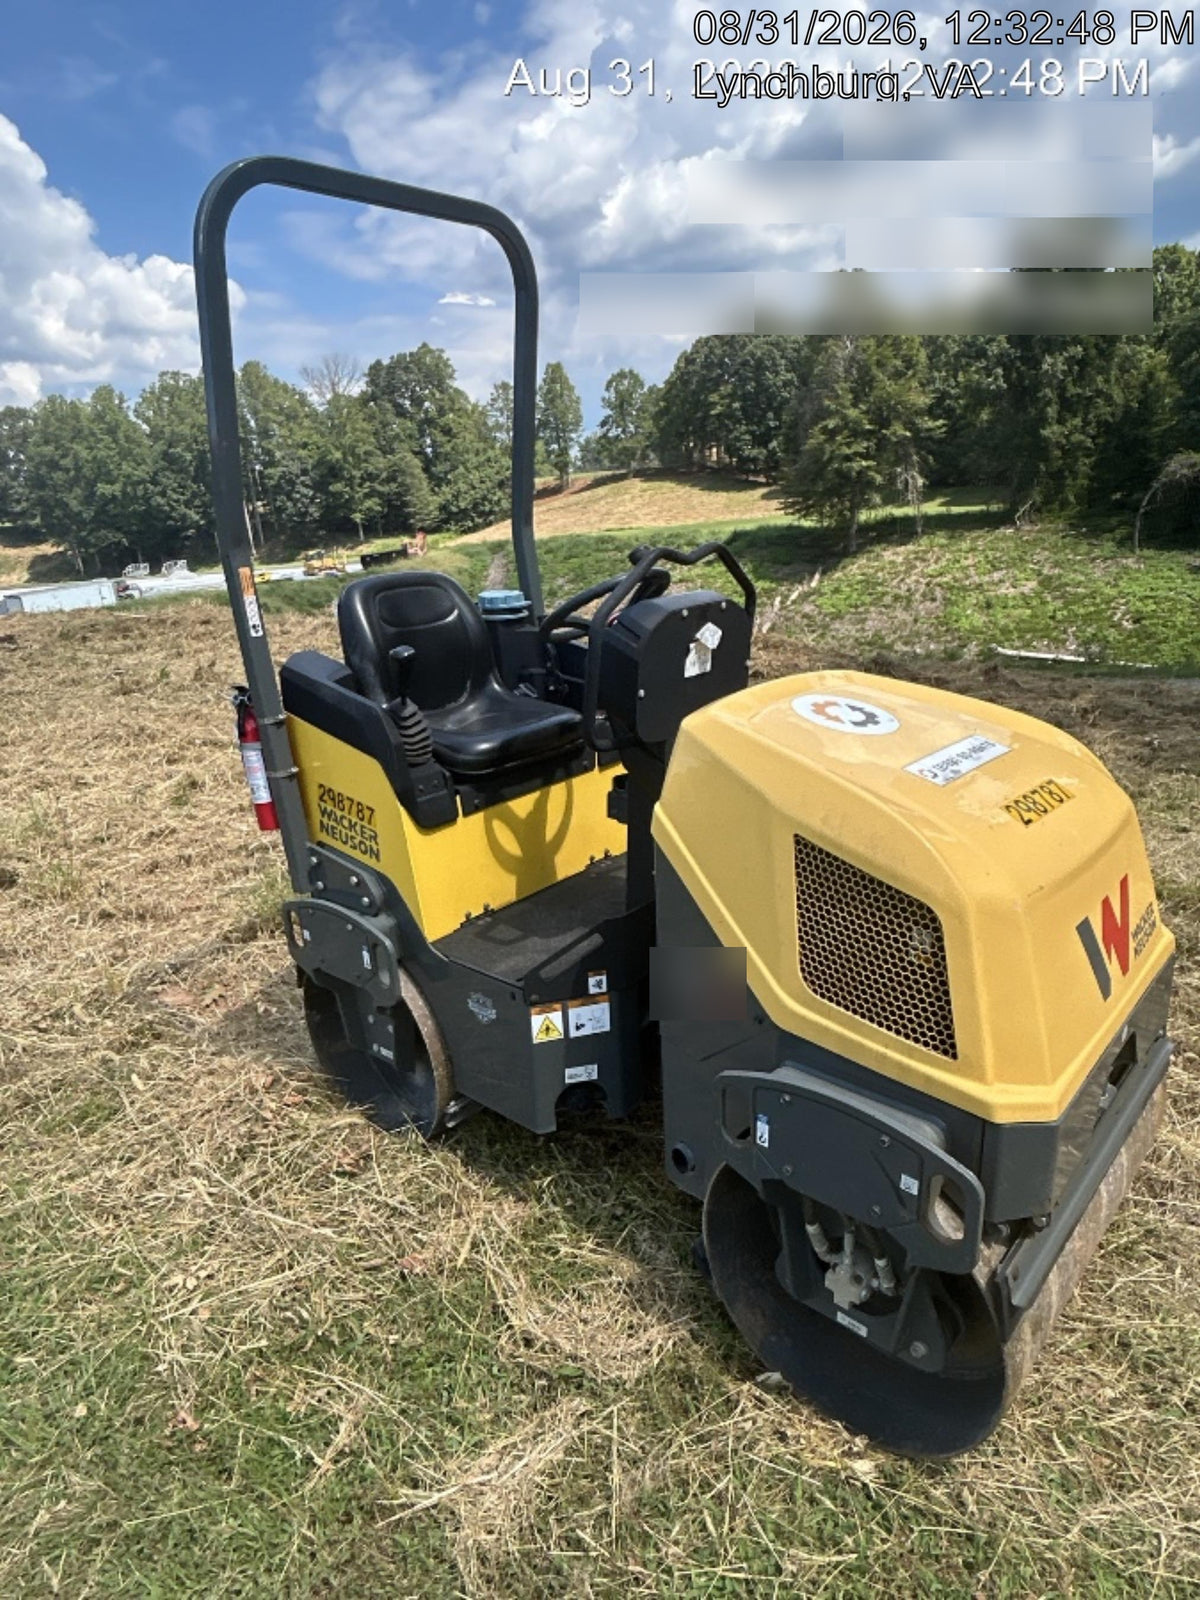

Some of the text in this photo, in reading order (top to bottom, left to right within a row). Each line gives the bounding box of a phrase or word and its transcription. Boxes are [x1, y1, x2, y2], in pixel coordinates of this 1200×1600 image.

[318, 783, 376, 826] 298787
[1004, 778, 1072, 826] 298787
[317, 803, 379, 847] WACKER
[319, 818, 381, 862] NEUSON
